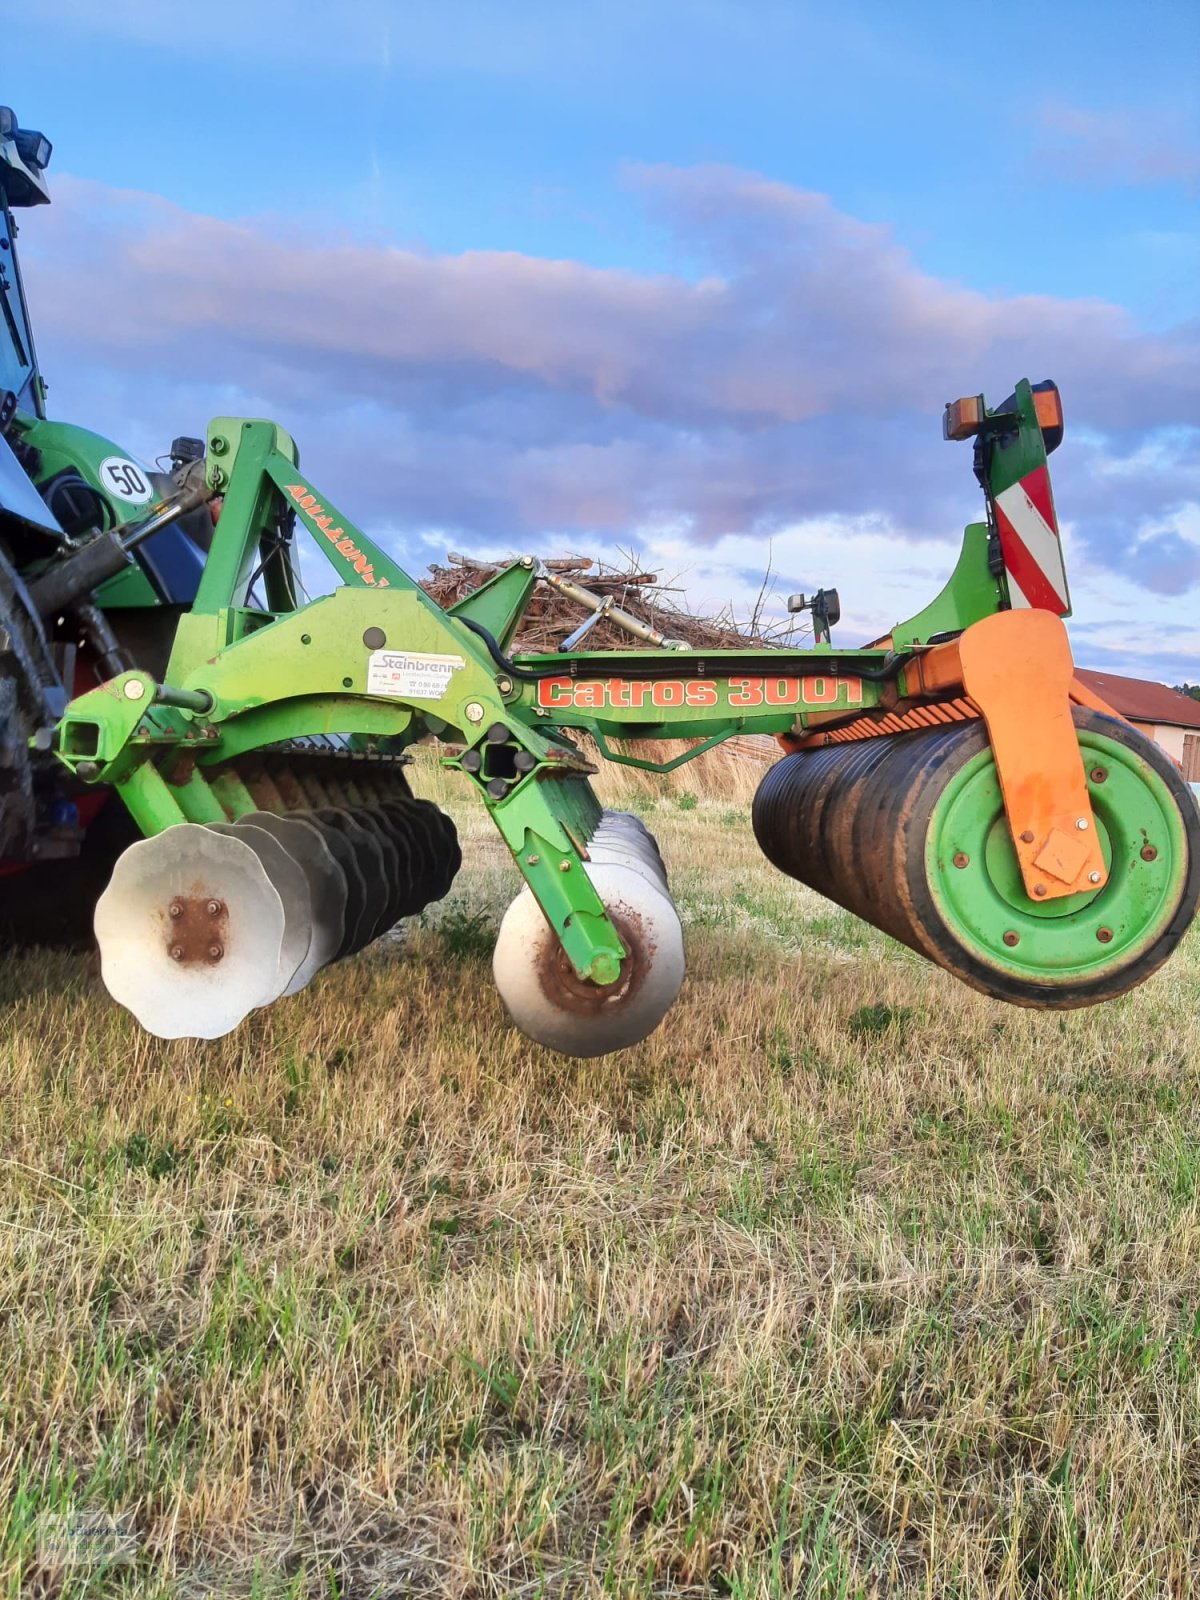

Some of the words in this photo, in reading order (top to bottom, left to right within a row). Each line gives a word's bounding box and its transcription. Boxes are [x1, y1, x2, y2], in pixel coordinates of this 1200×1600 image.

[107, 464, 146, 496] 50
[537, 676, 718, 708] Catros
[728, 675, 864, 707] 3001
